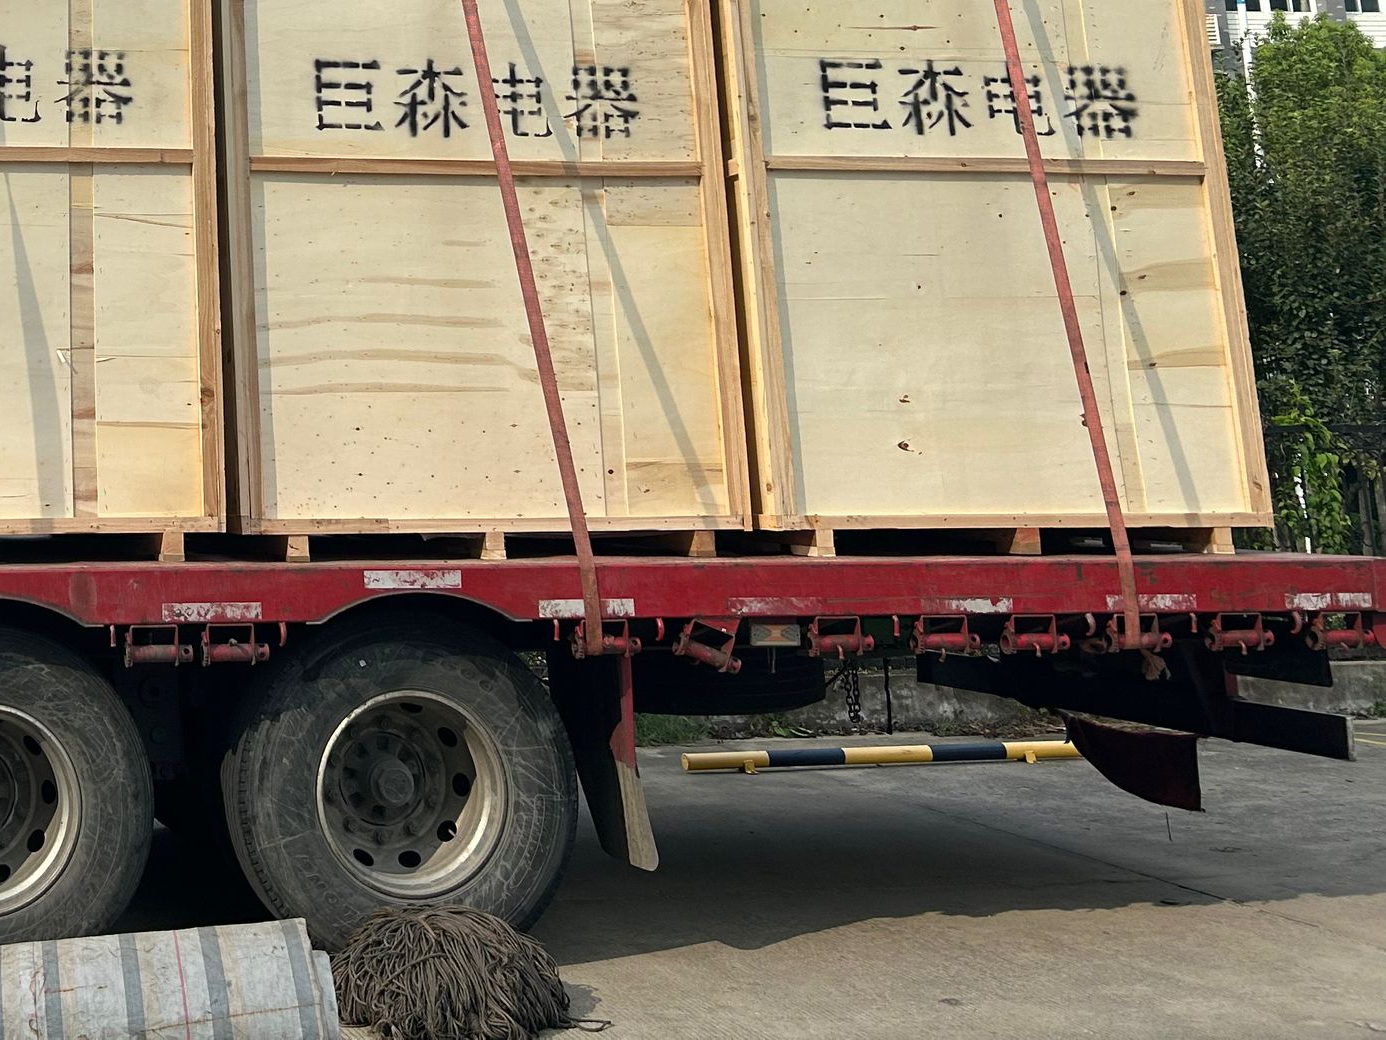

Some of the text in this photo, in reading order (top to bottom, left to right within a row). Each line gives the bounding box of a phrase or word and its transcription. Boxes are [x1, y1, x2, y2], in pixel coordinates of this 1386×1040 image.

[314, 59, 640, 138] 巨森电器
[819, 59, 1139, 138] 巨森电器
